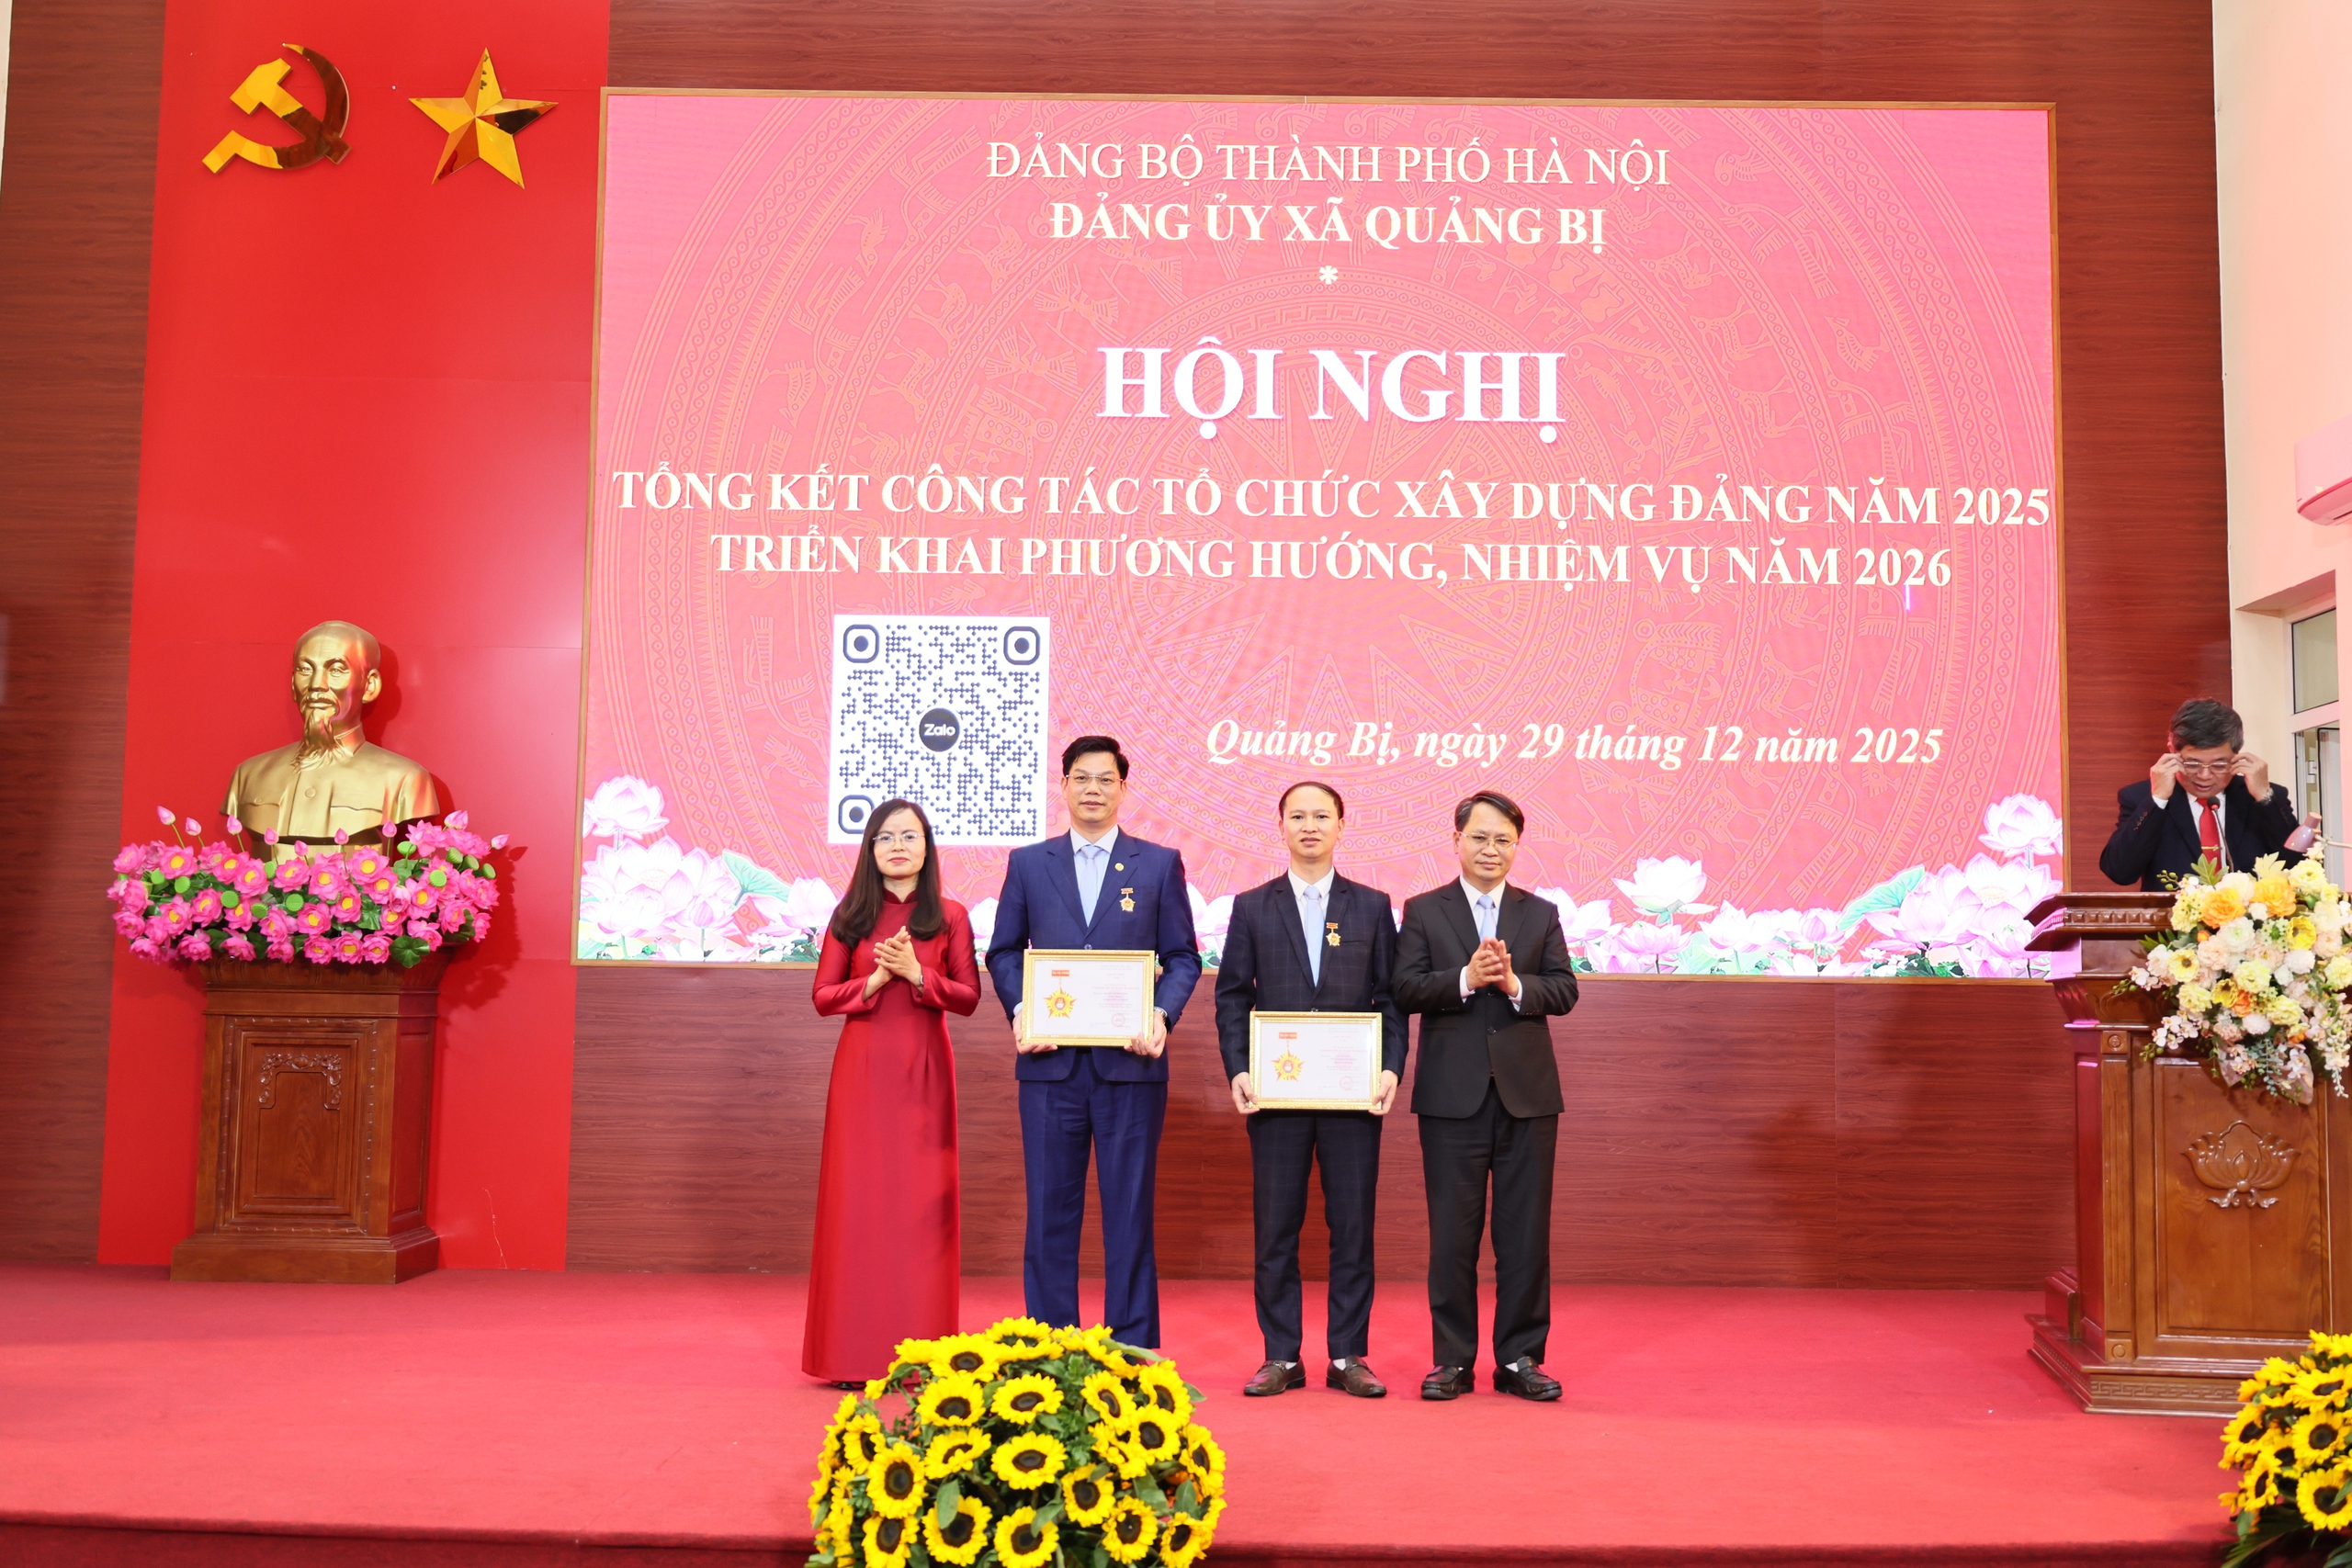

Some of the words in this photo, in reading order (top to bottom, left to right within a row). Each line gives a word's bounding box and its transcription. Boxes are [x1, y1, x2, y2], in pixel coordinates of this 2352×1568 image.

[987, 132, 1125, 177] ĐẢNG
[1137, 134, 1203, 186] BỘ
[1216, 134, 1382, 181] THÀNH
[1396, 138, 1489, 182] PHỐ
[1504, 138, 1572, 183] HÀ
[1584, 139, 1669, 191] NỘI
[1050, 192, 1191, 240] ĐẢNG
[1204, 194, 1272, 240] ỦY
[1283, 197, 1351, 241] XÃ
[1366, 196, 1544, 249] QUẢNG
[1556, 209, 1606, 254] BỊ
[1097, 336, 1283, 439] HỘI
[1309, 350, 1566, 443] NGHỊ
[613, 462, 754, 510] TỔNG
[767, 464, 868, 511] KẾT
[882, 464, 1026, 513] CÔNG
[1039, 467, 1138, 514] TÁC
[1153, 468, 1221, 515] TỔ
[1236, 469, 1379, 517] CHỨC
[1394, 469, 1498, 518] XÂY
[1510, 478, 1656, 529] DỰNG
[1669, 474, 1812, 523] ĐẢNG
[1825, 477, 1940, 524] NĂM
[1953, 488, 2049, 525] 2025
[711, 525, 863, 572] TRIỂN
[876, 537, 1005, 573] KHAI
[1019, 534, 1235, 577] PHƯƠNG
[1249, 532, 1447, 588] HƯỚNG,
[1461, 539, 1630, 589] NHIỆM
[1643, 547, 1713, 592] VỤ
[1725, 537, 1841, 584] NĂM
[1855, 548, 1951, 586] 2026
[924, 723, 956, 737] Zalo
[1207, 720, 1337, 766] Quảng
[1346, 722, 1399, 765] Bị,
[1414, 723, 1507, 768] ngày
[1518, 724, 1564, 758] 29
[1576, 725, 1686, 770] tháng
[1698, 726, 1743, 761] 12
[1755, 728, 1838, 762] năm
[1850, 728, 1943, 762] 2025
